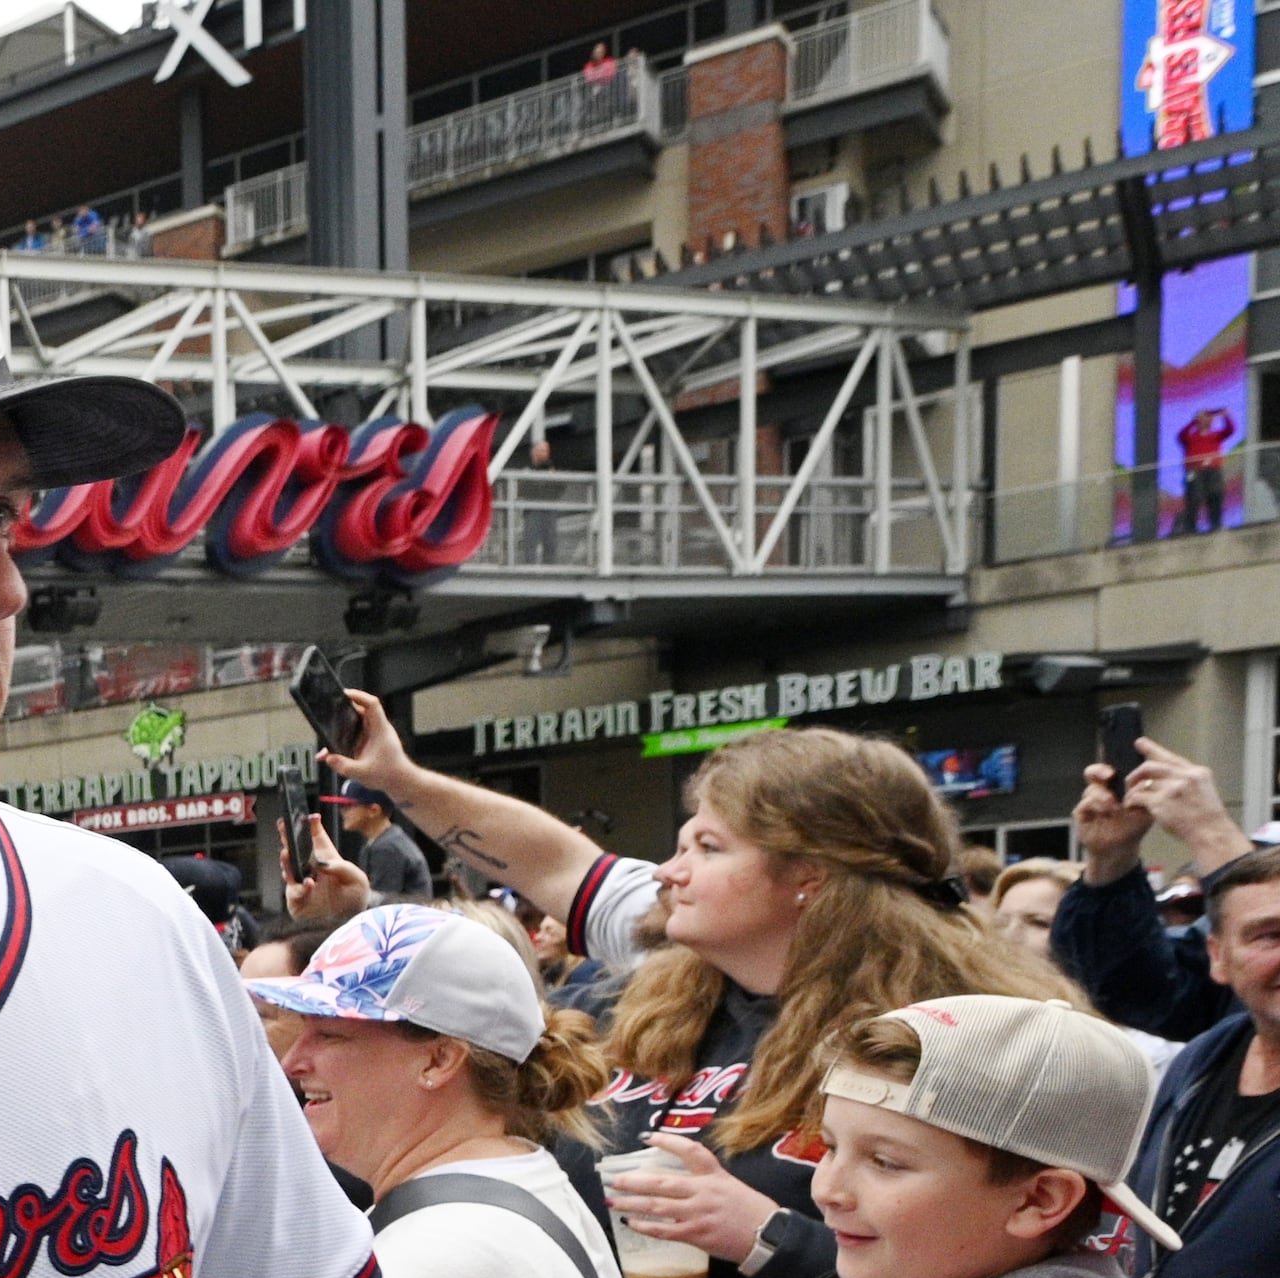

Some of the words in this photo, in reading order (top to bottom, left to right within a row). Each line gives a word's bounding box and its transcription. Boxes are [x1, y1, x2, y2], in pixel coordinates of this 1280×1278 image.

[468, 700, 640, 757] TERRAPIN
[649, 683, 767, 733] FRESH
[776, 663, 900, 718] BREW
[909, 652, 1003, 701] BAR
[6, 768, 153, 813] TERRAPIN
